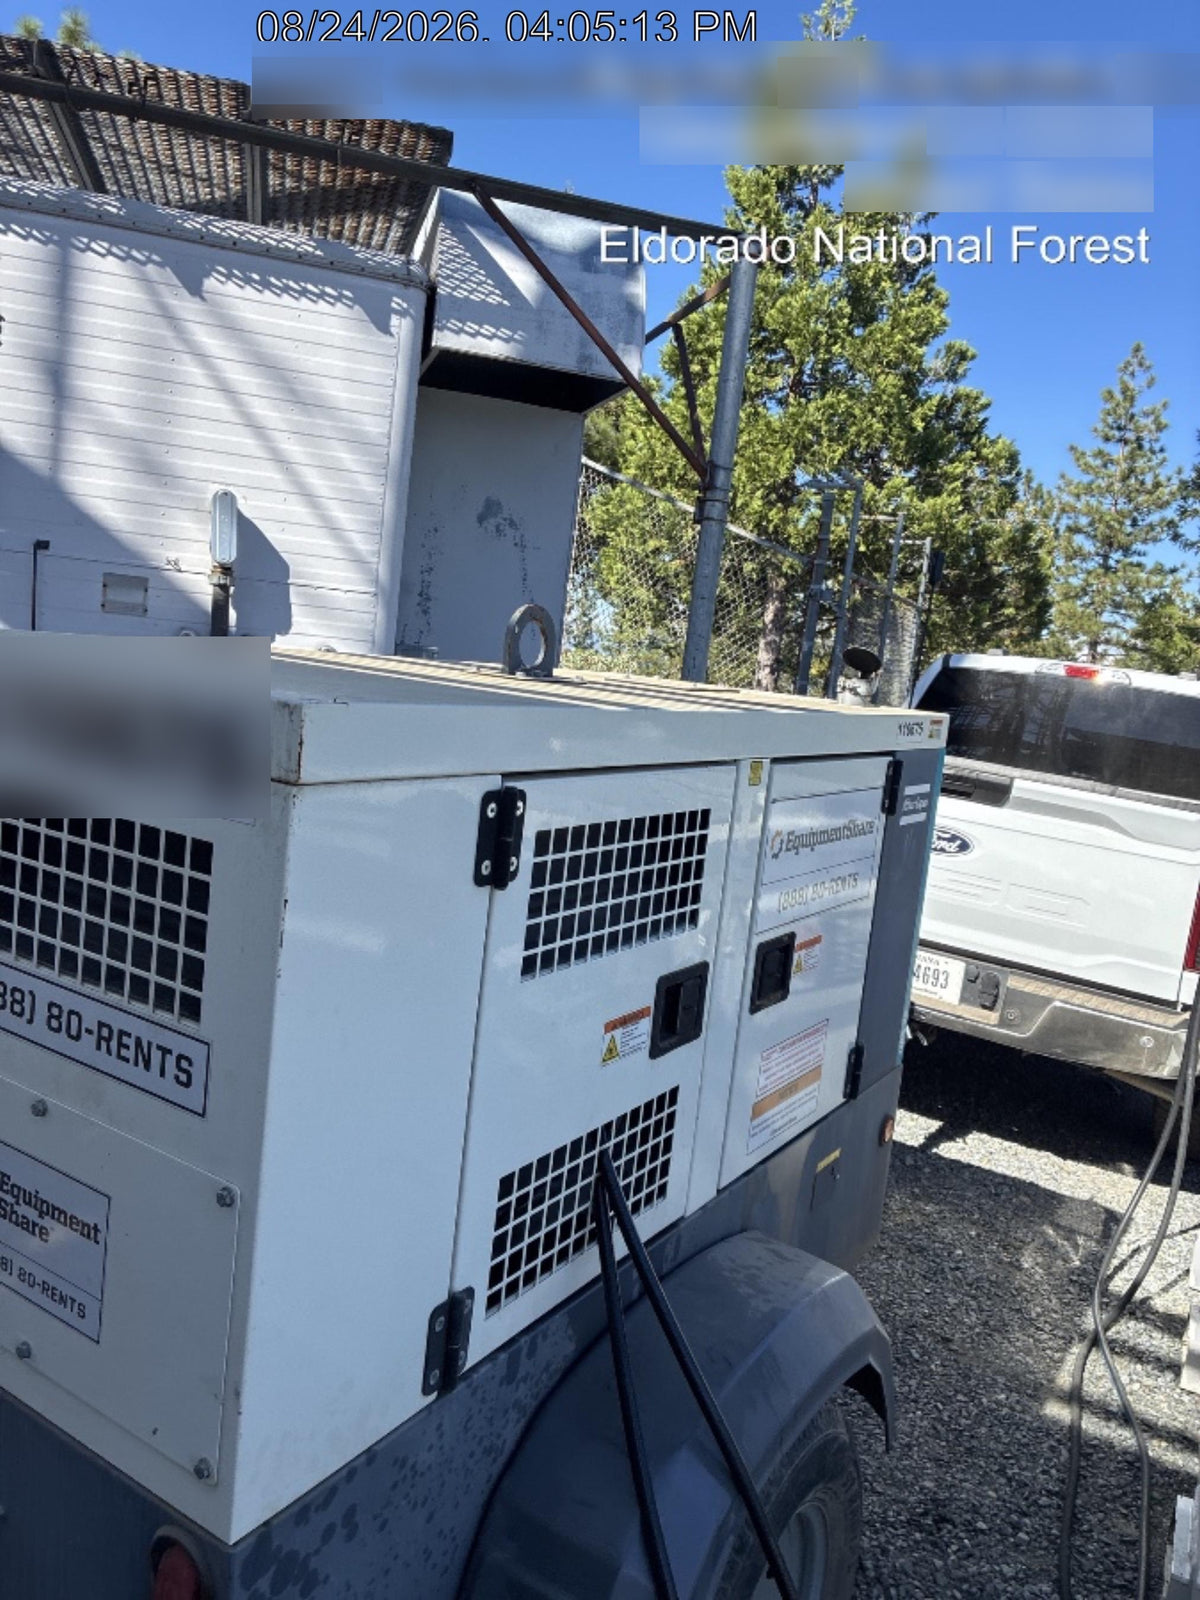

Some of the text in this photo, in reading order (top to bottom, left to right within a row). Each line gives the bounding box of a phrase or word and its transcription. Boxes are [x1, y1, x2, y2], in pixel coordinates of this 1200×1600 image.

[46, 1001, 194, 1089] 80-RENTS
[0, 1170, 102, 1245] Equipment
[0, 1196, 49, 1243] Share
[17, 1267, 87, 1320] 80-RENTS
